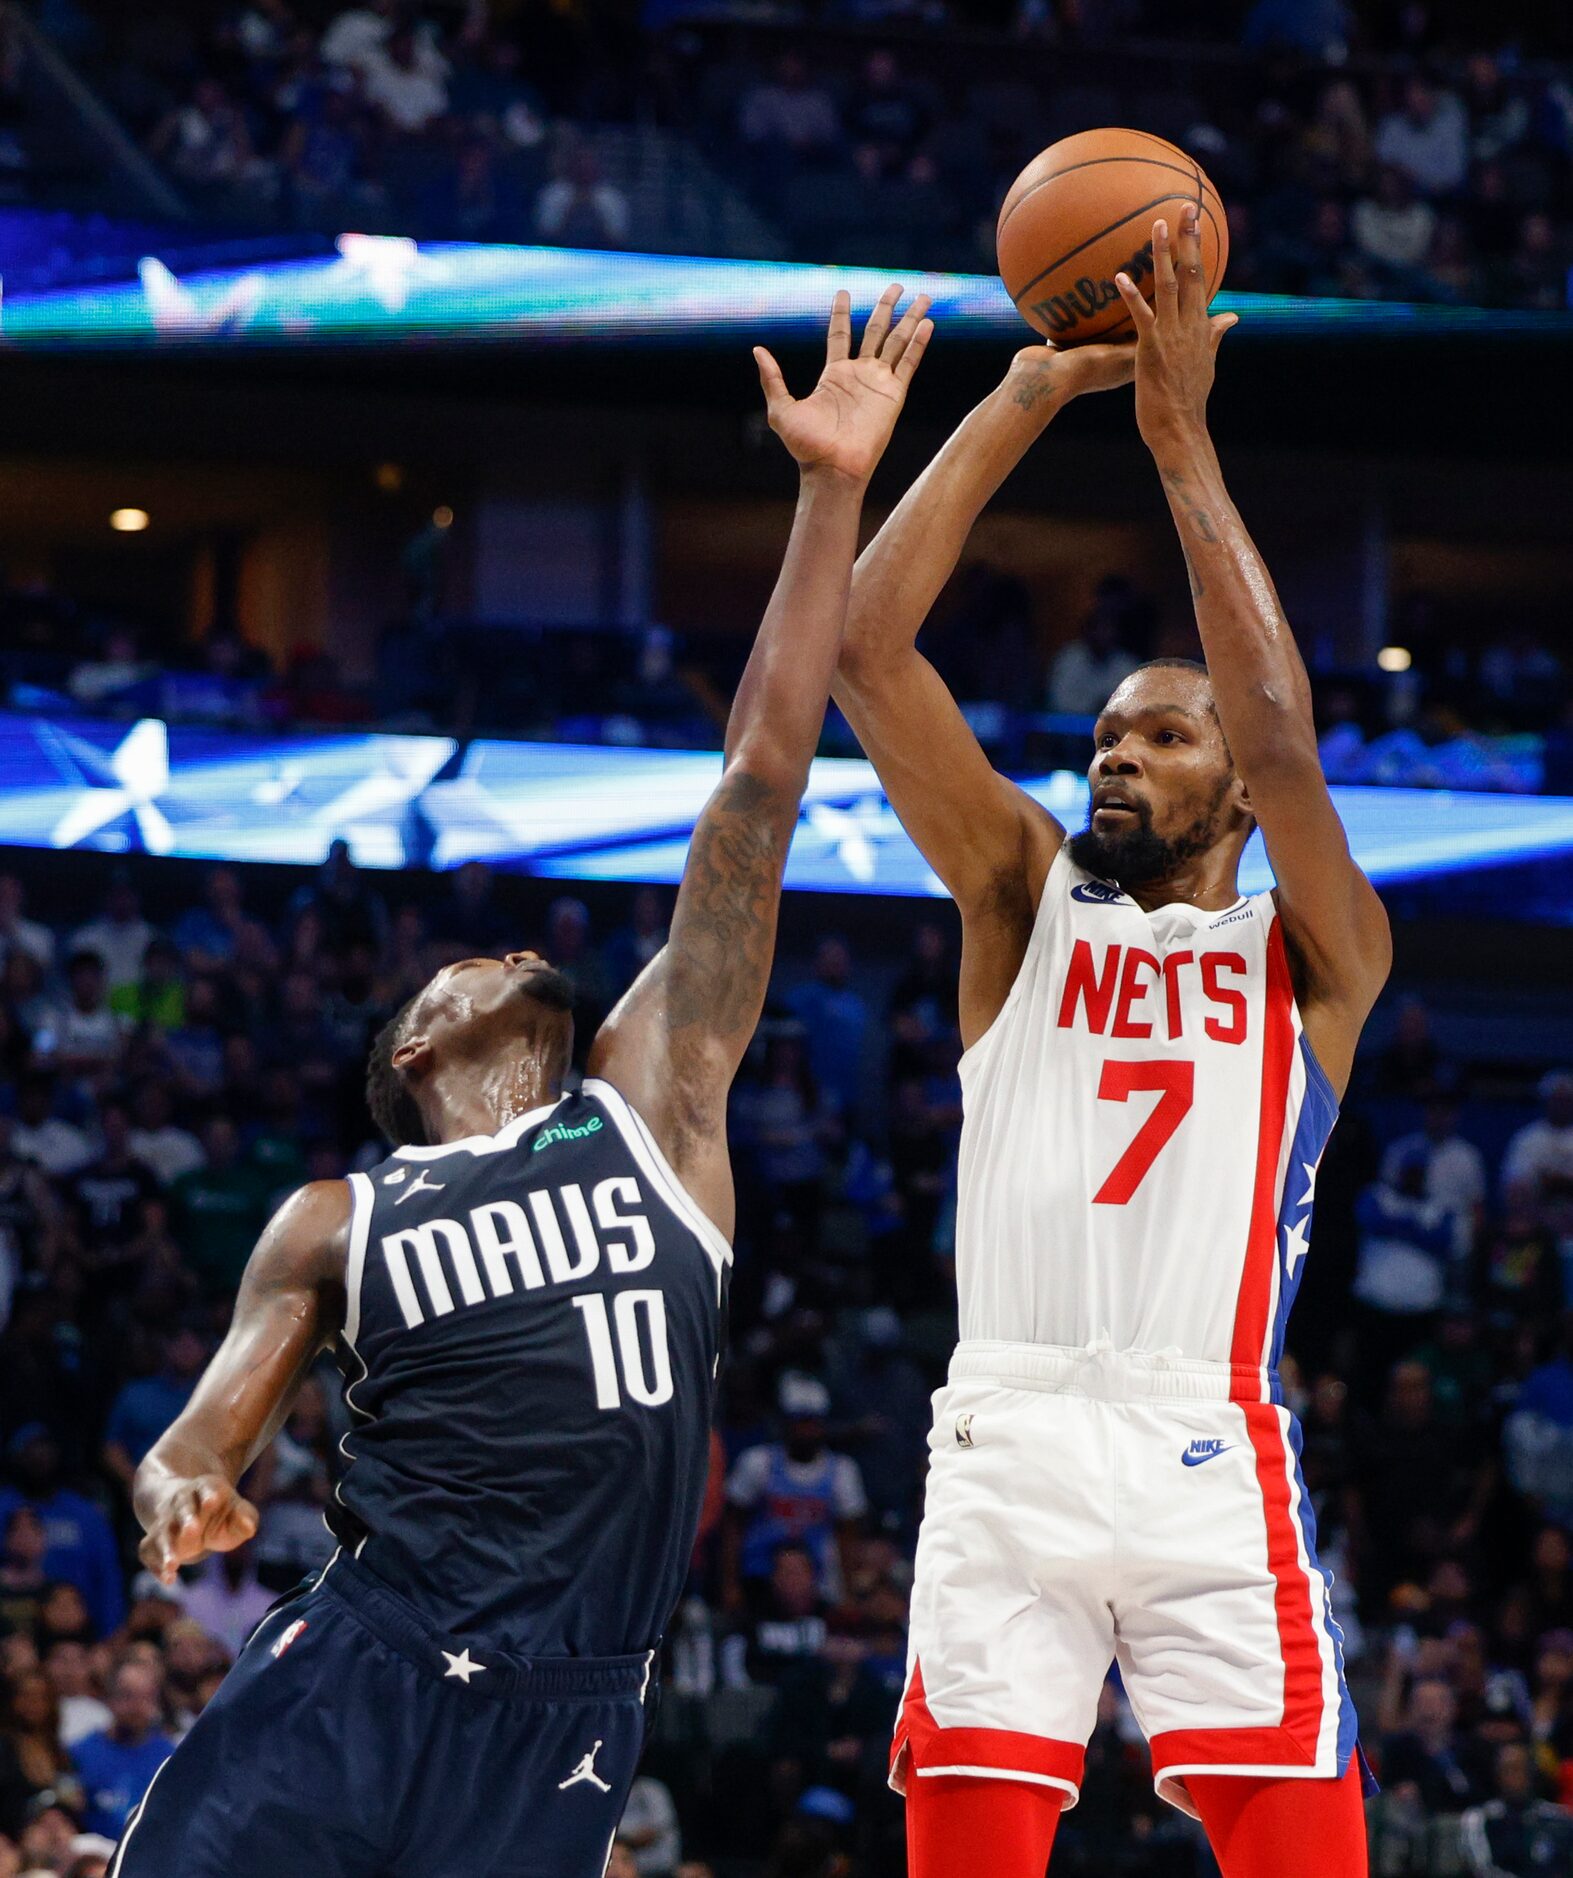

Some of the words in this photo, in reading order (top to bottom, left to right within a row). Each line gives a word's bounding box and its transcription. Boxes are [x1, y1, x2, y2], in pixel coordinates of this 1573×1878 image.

[1057, 938, 1247, 1046] NETS
[533, 1116, 603, 1151] chime
[1091, 1059, 1195, 1205] 7
[381, 1177, 655, 1330] MAVS
[572, 1289, 674, 1410] 10
[1190, 1439, 1225, 1453] NIKE
